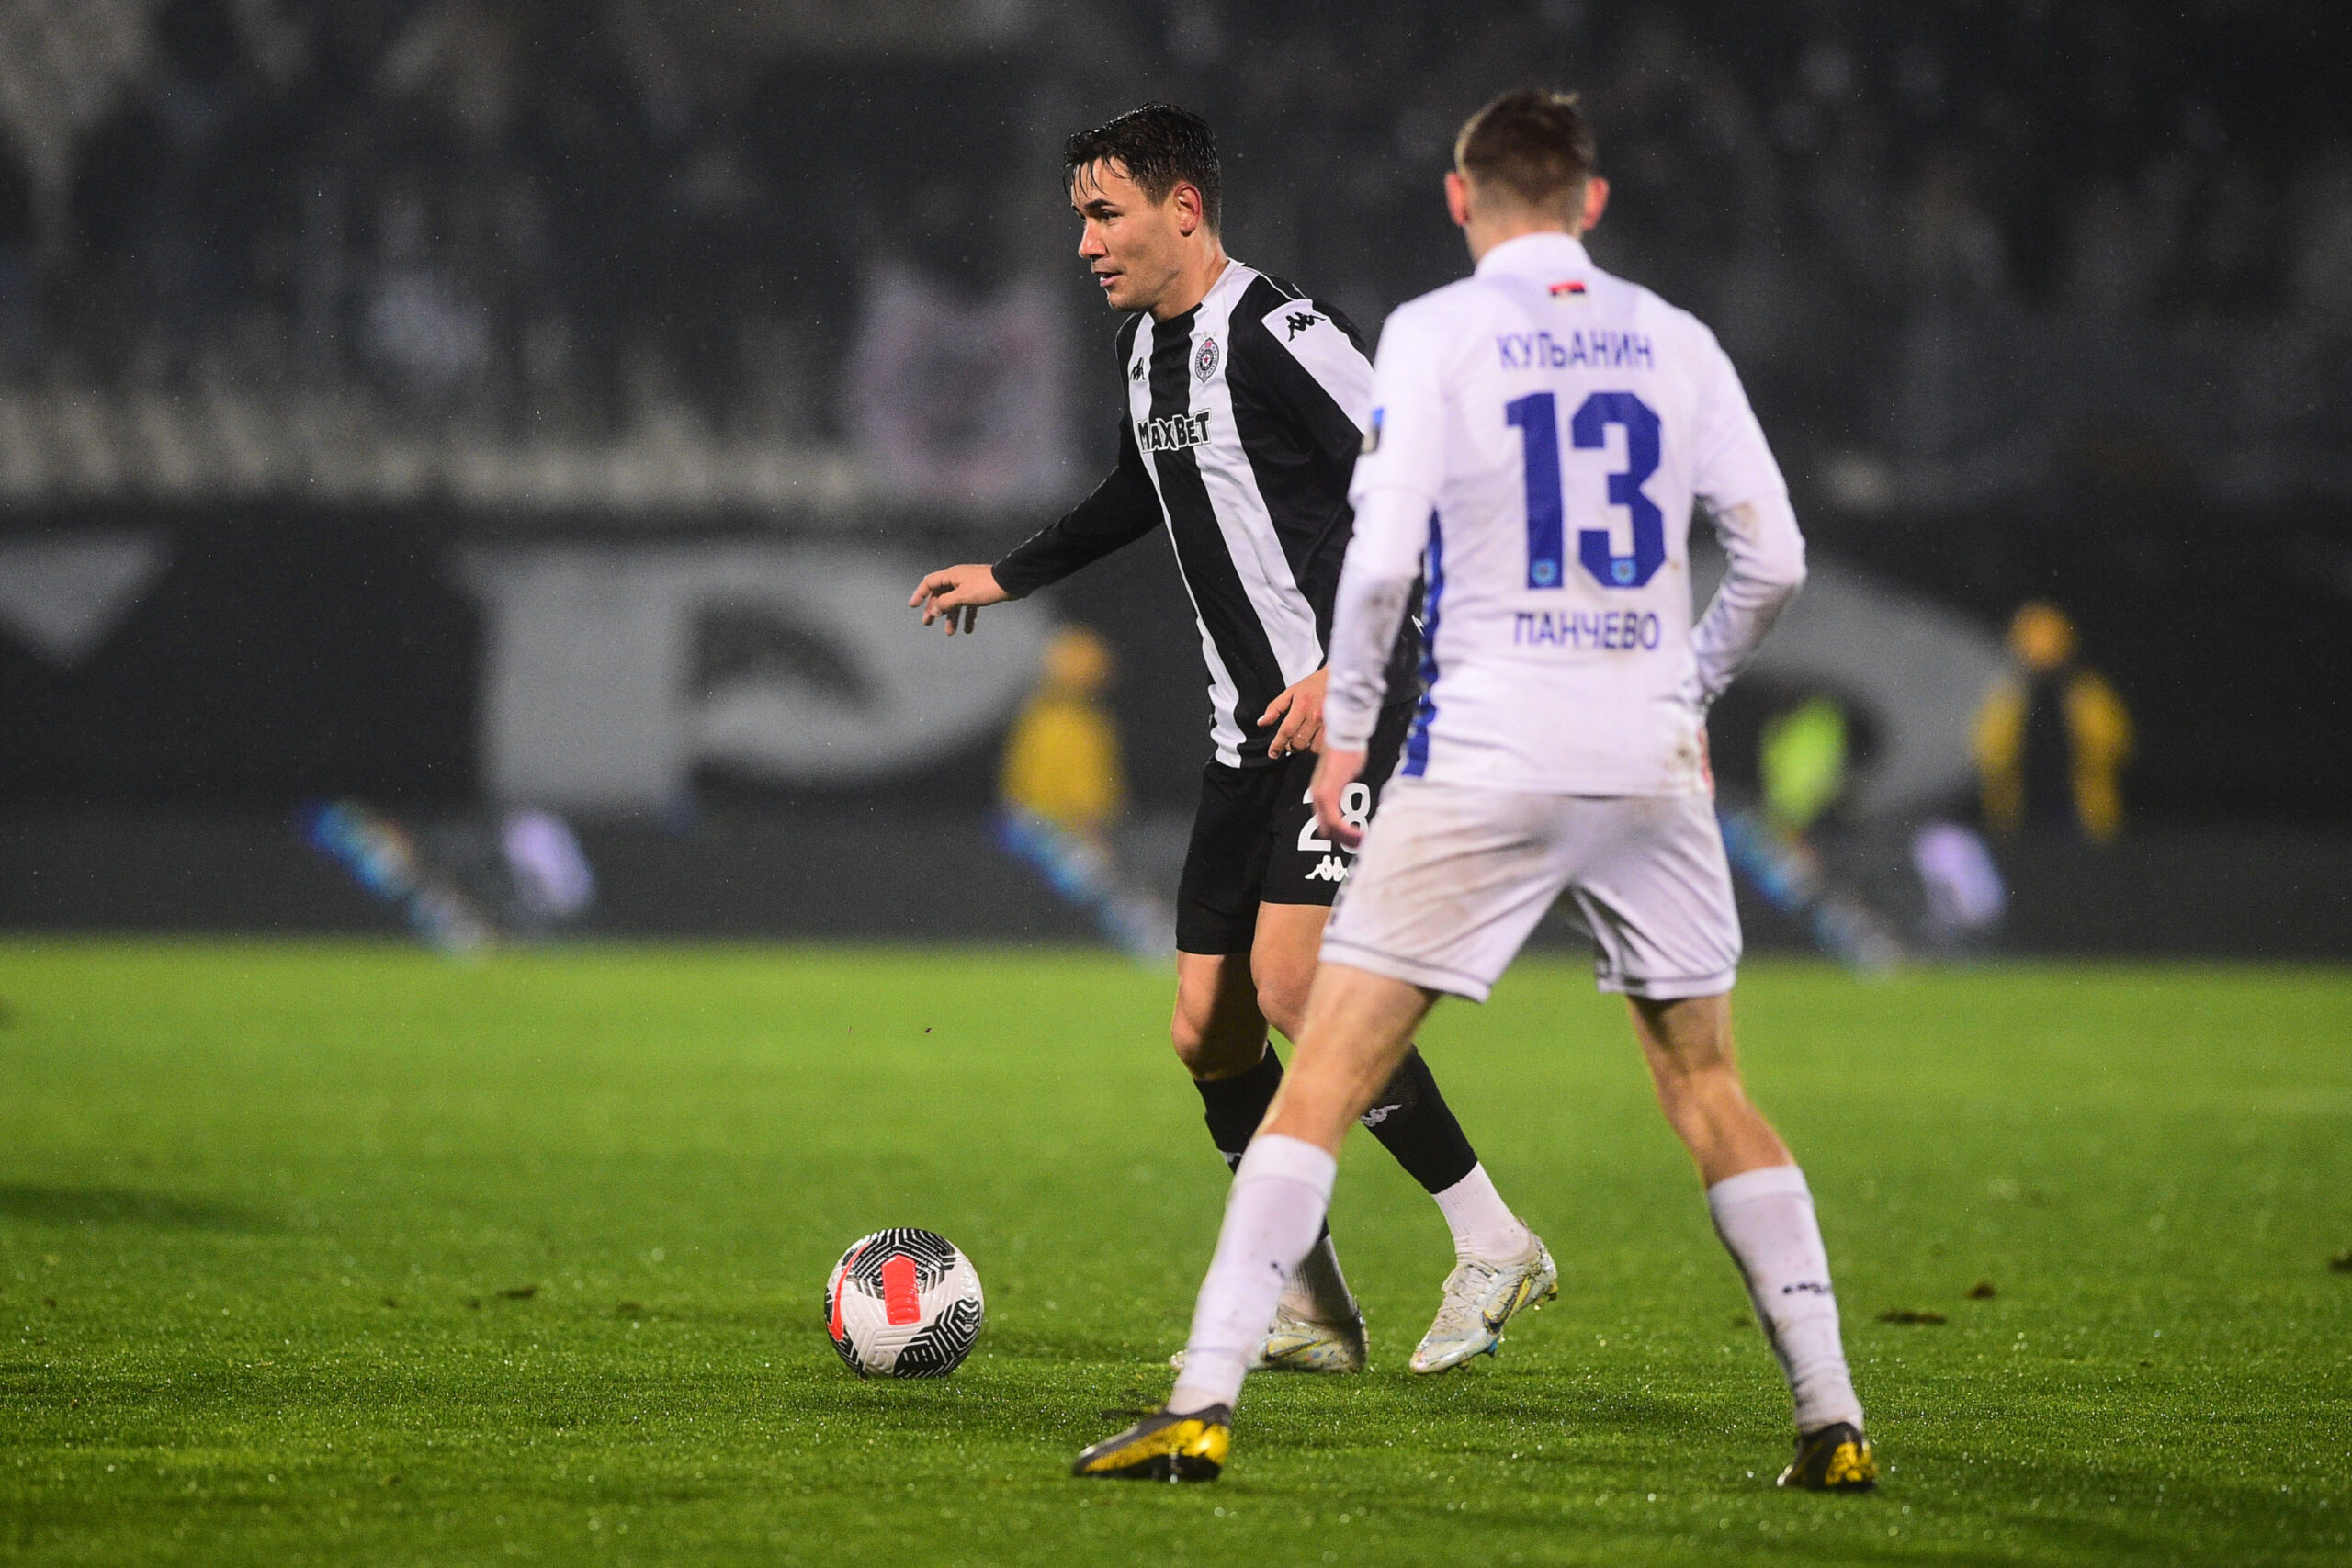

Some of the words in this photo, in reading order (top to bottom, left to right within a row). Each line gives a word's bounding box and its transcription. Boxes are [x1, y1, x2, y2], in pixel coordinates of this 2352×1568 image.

[1496, 329, 1655, 370] КУЉАНИН
[1137, 409, 1211, 453] MAXBET
[1506, 392, 1666, 589] 13
[1514, 611, 1661, 650] ПАНЧЕВО
[1297, 782, 1371, 854] 28
